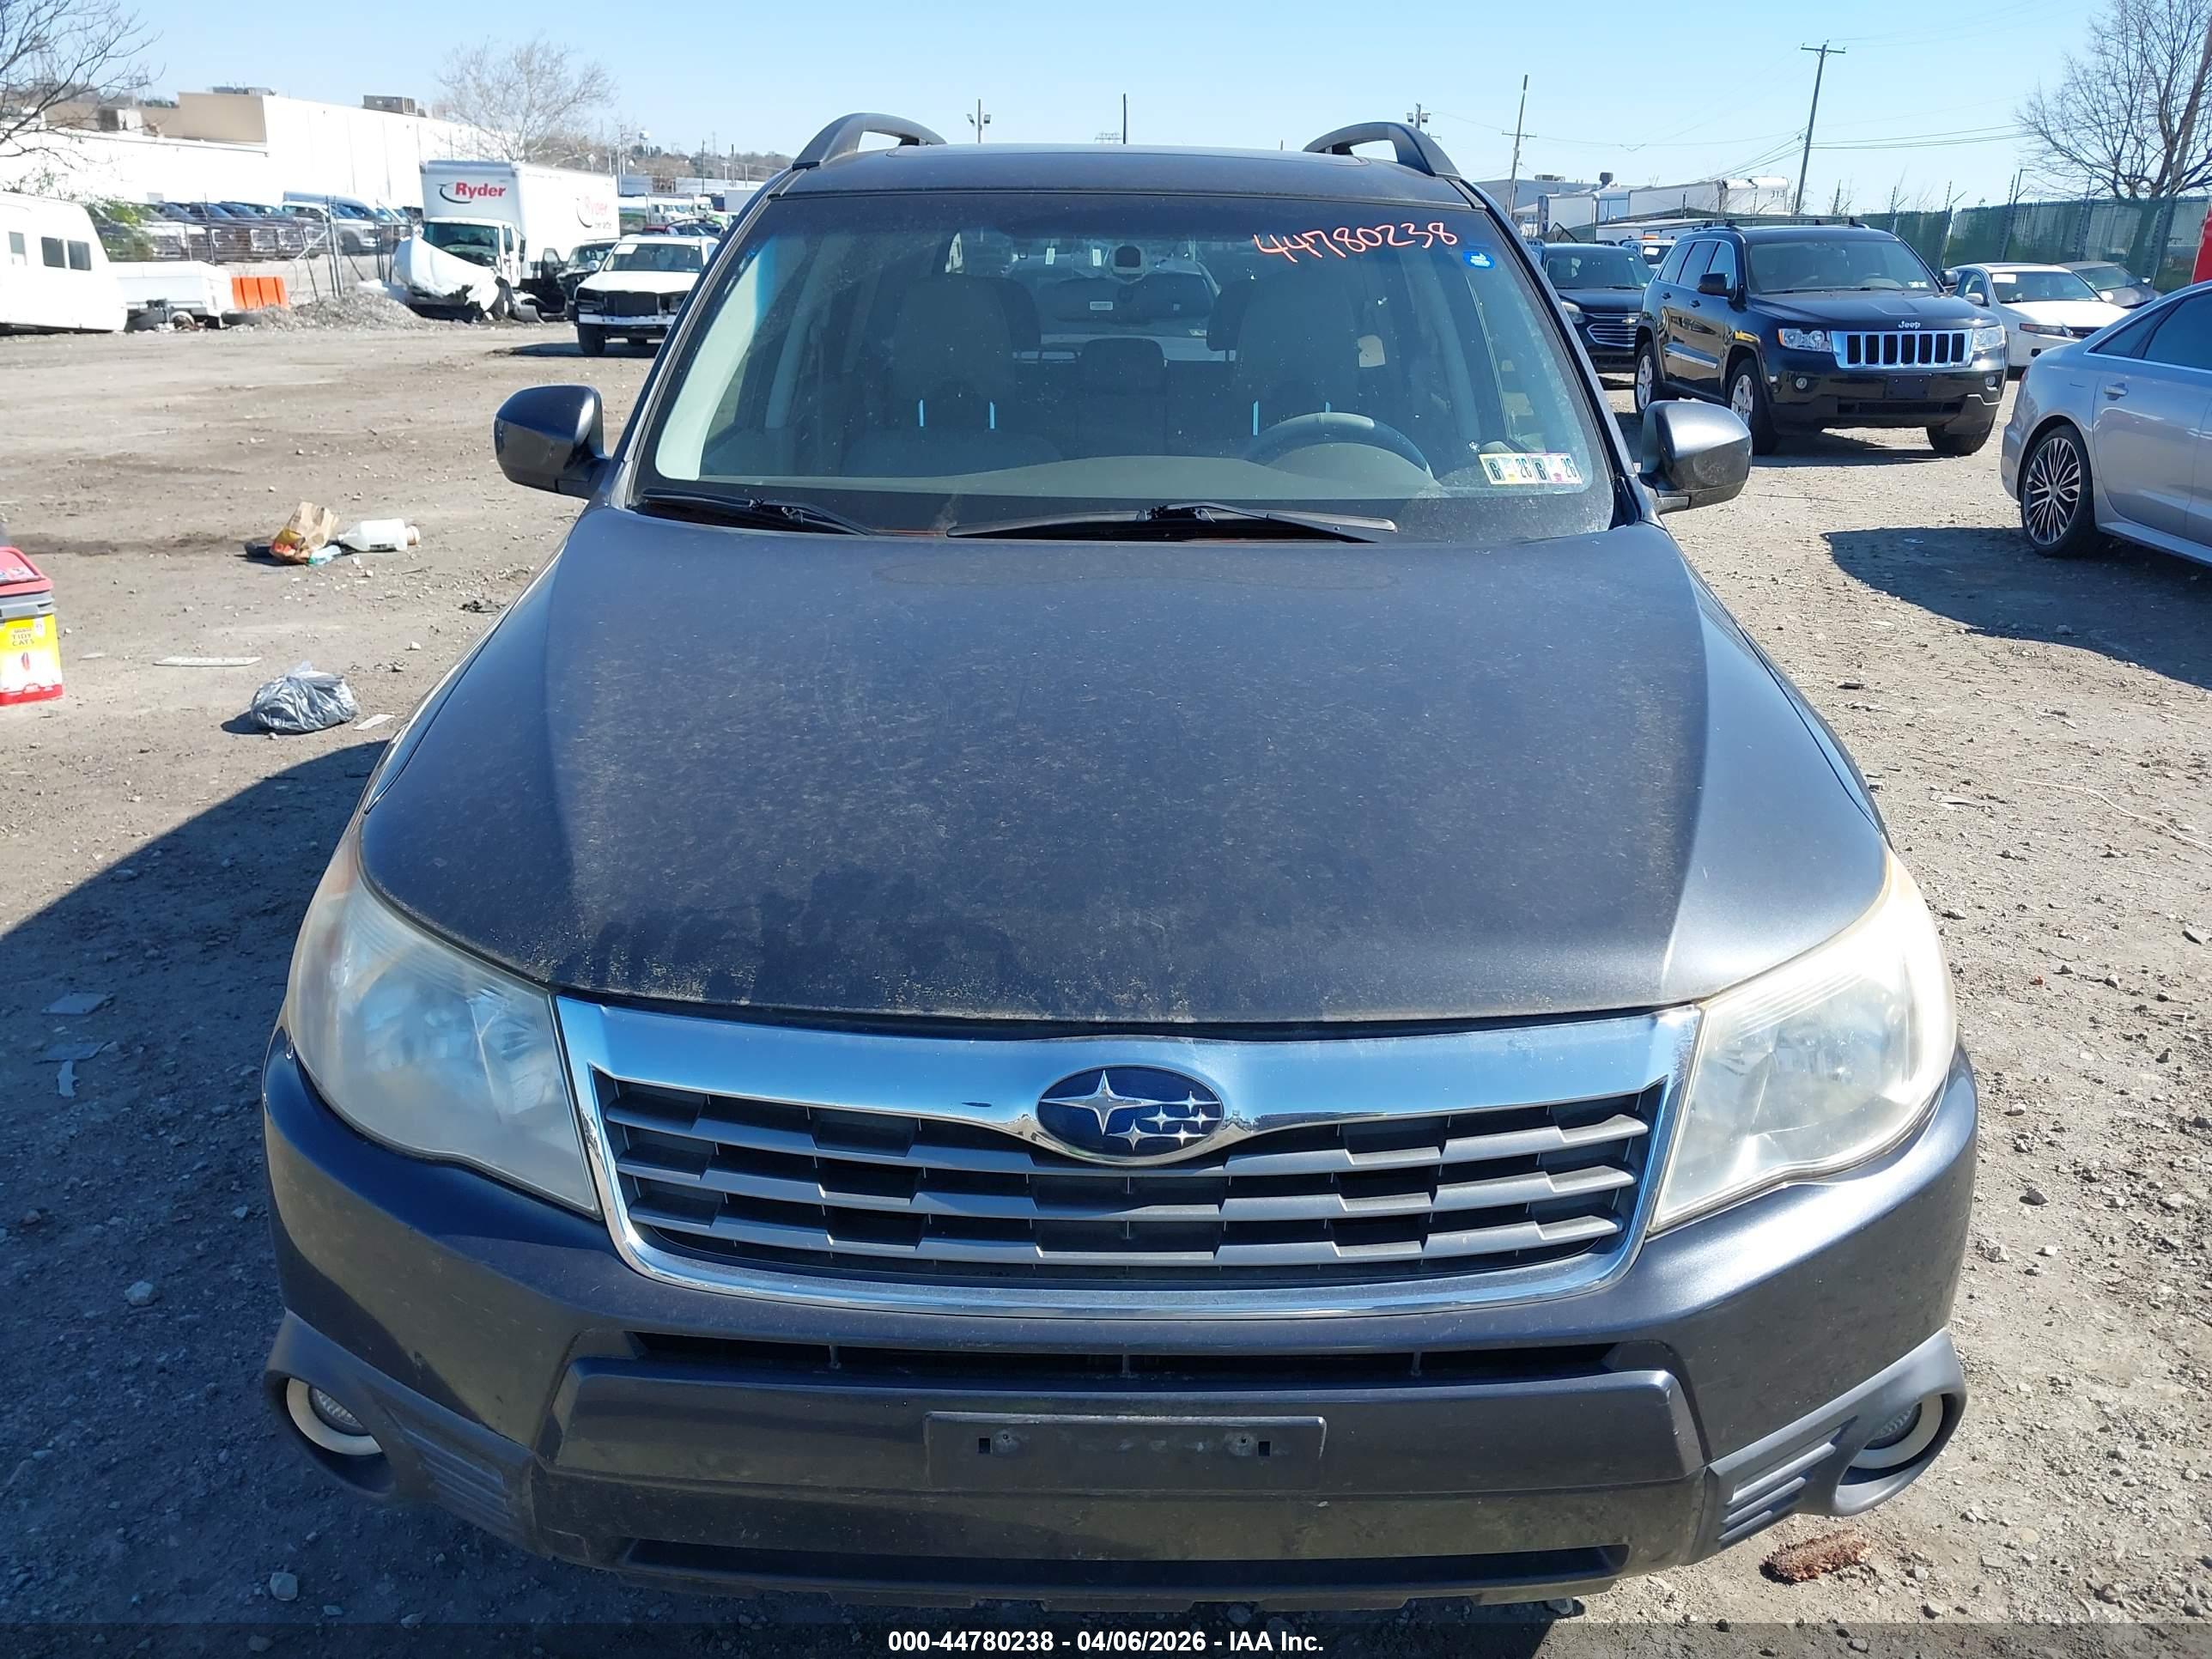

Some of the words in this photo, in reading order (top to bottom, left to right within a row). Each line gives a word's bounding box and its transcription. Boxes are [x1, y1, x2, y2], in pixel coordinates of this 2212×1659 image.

[455, 182, 506, 198] Ryder
[1253, 222, 1458, 264] 44780238
[1898, 320, 1921, 330] Jeep
[1488, 461, 1502, 481] 6
[1516, 458, 1533, 478] 26
[1534, 461, 1547, 481] 6
[1560, 458, 1577, 478] 26
[12, 638, 35, 647] CATS
